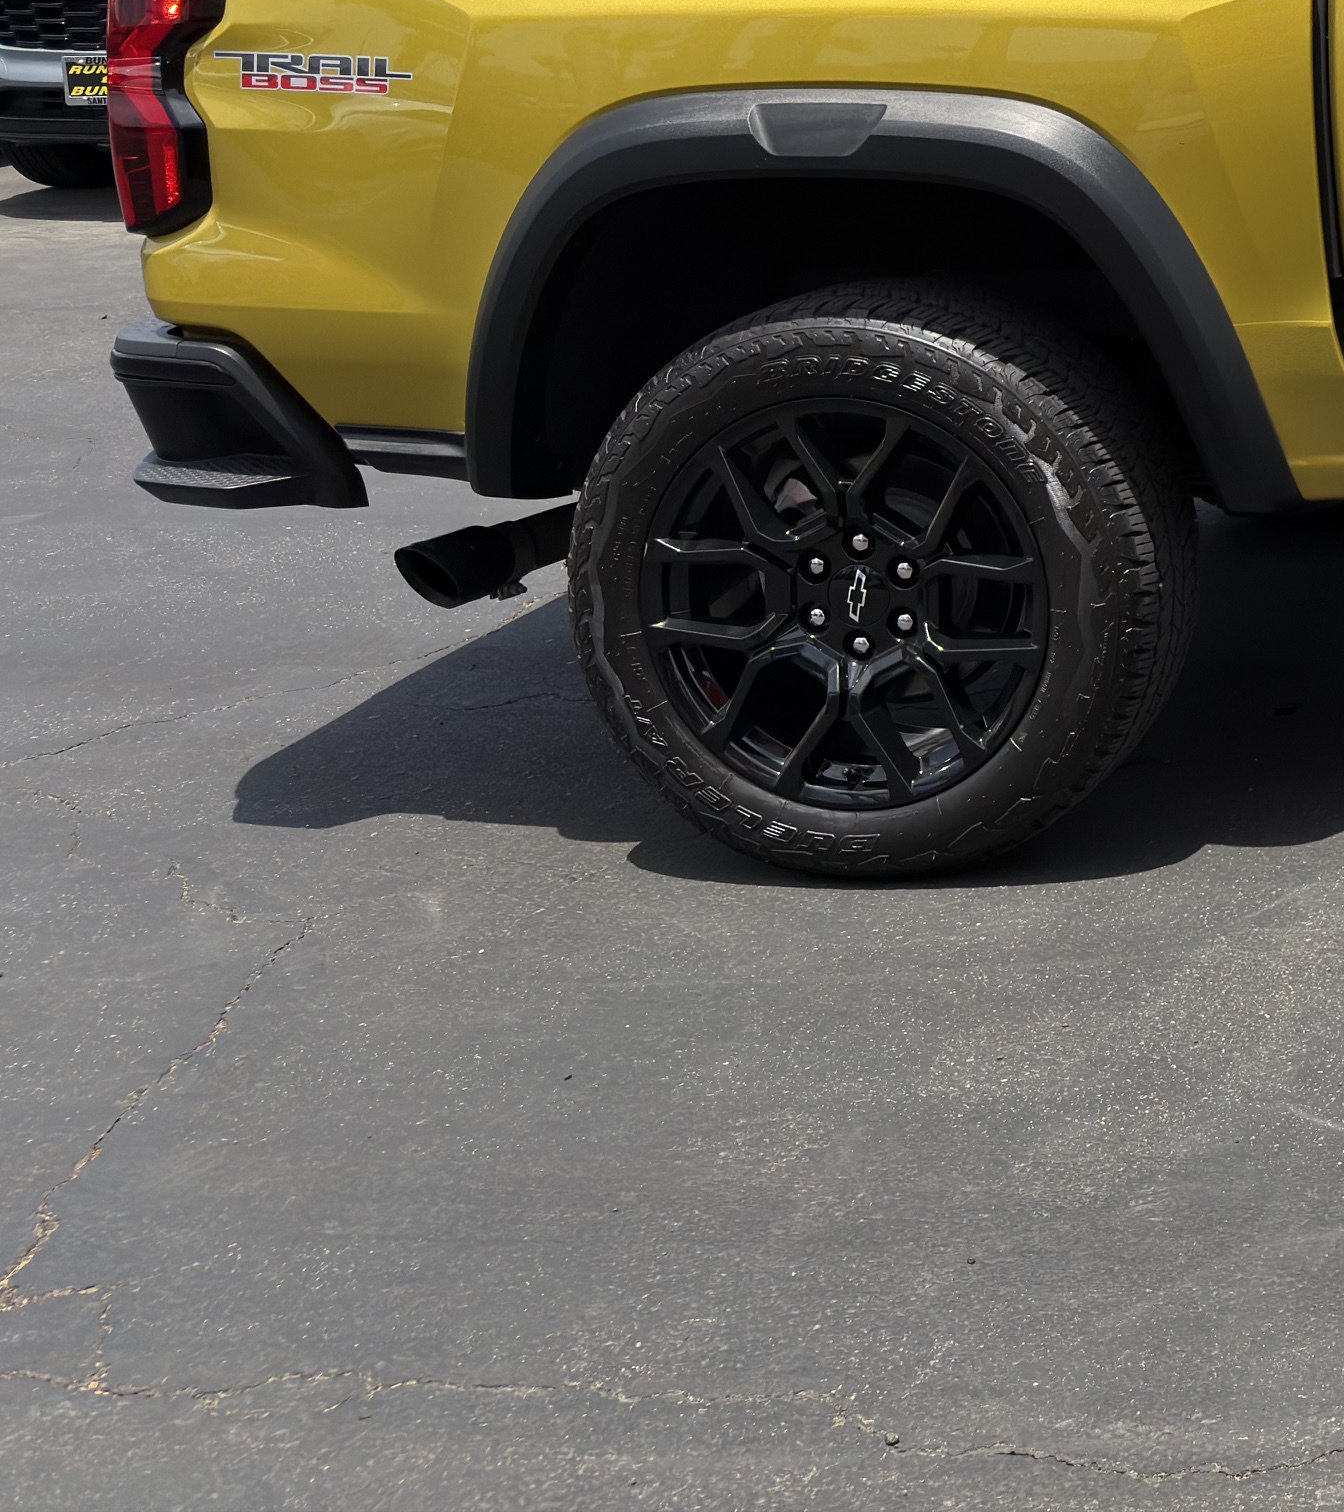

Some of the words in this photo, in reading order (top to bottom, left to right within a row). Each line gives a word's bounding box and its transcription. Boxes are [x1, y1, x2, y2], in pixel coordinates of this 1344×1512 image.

[214, 51, 412, 80] TRAIL
[240, 73, 389, 95] BOSS
[756, 353, 1048, 486] BRIDGESTONE
[664, 756, 881, 853] DUELER
